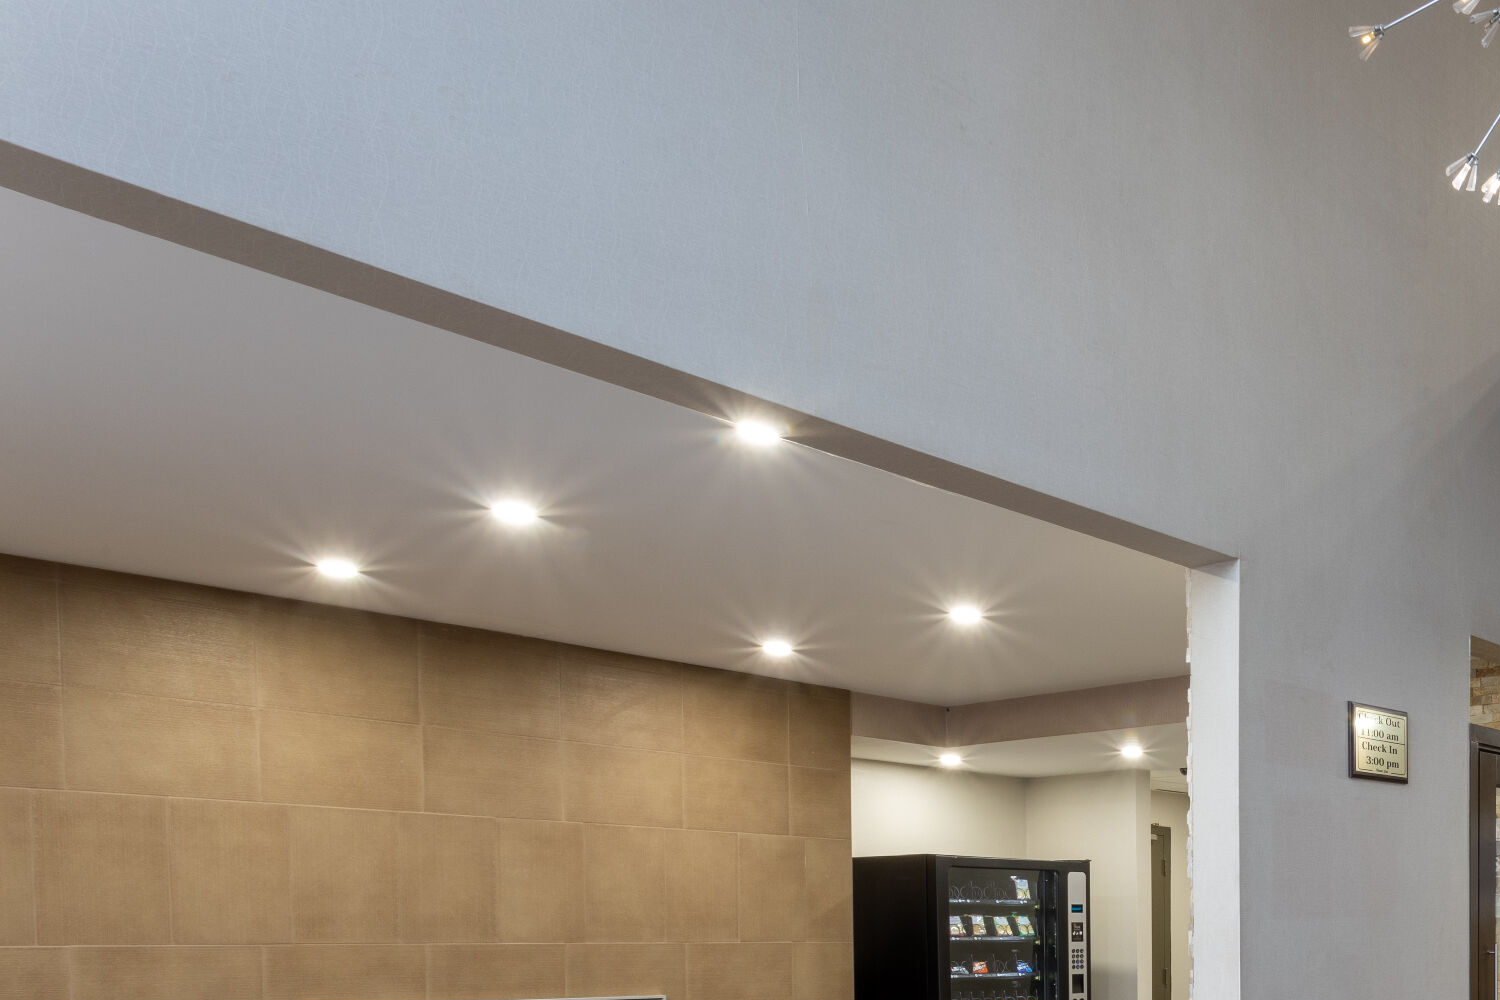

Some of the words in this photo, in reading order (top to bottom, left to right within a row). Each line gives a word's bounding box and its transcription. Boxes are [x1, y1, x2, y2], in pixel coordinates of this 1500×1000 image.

[1386, 718, 1400, 728] Out
[1386, 733, 1399, 741] am
[1362, 741, 1387, 753] Check
[1389, 745, 1398, 755] In
[1366, 756, 1385, 766] 3:00
[1386, 761, 1399, 769] pm
